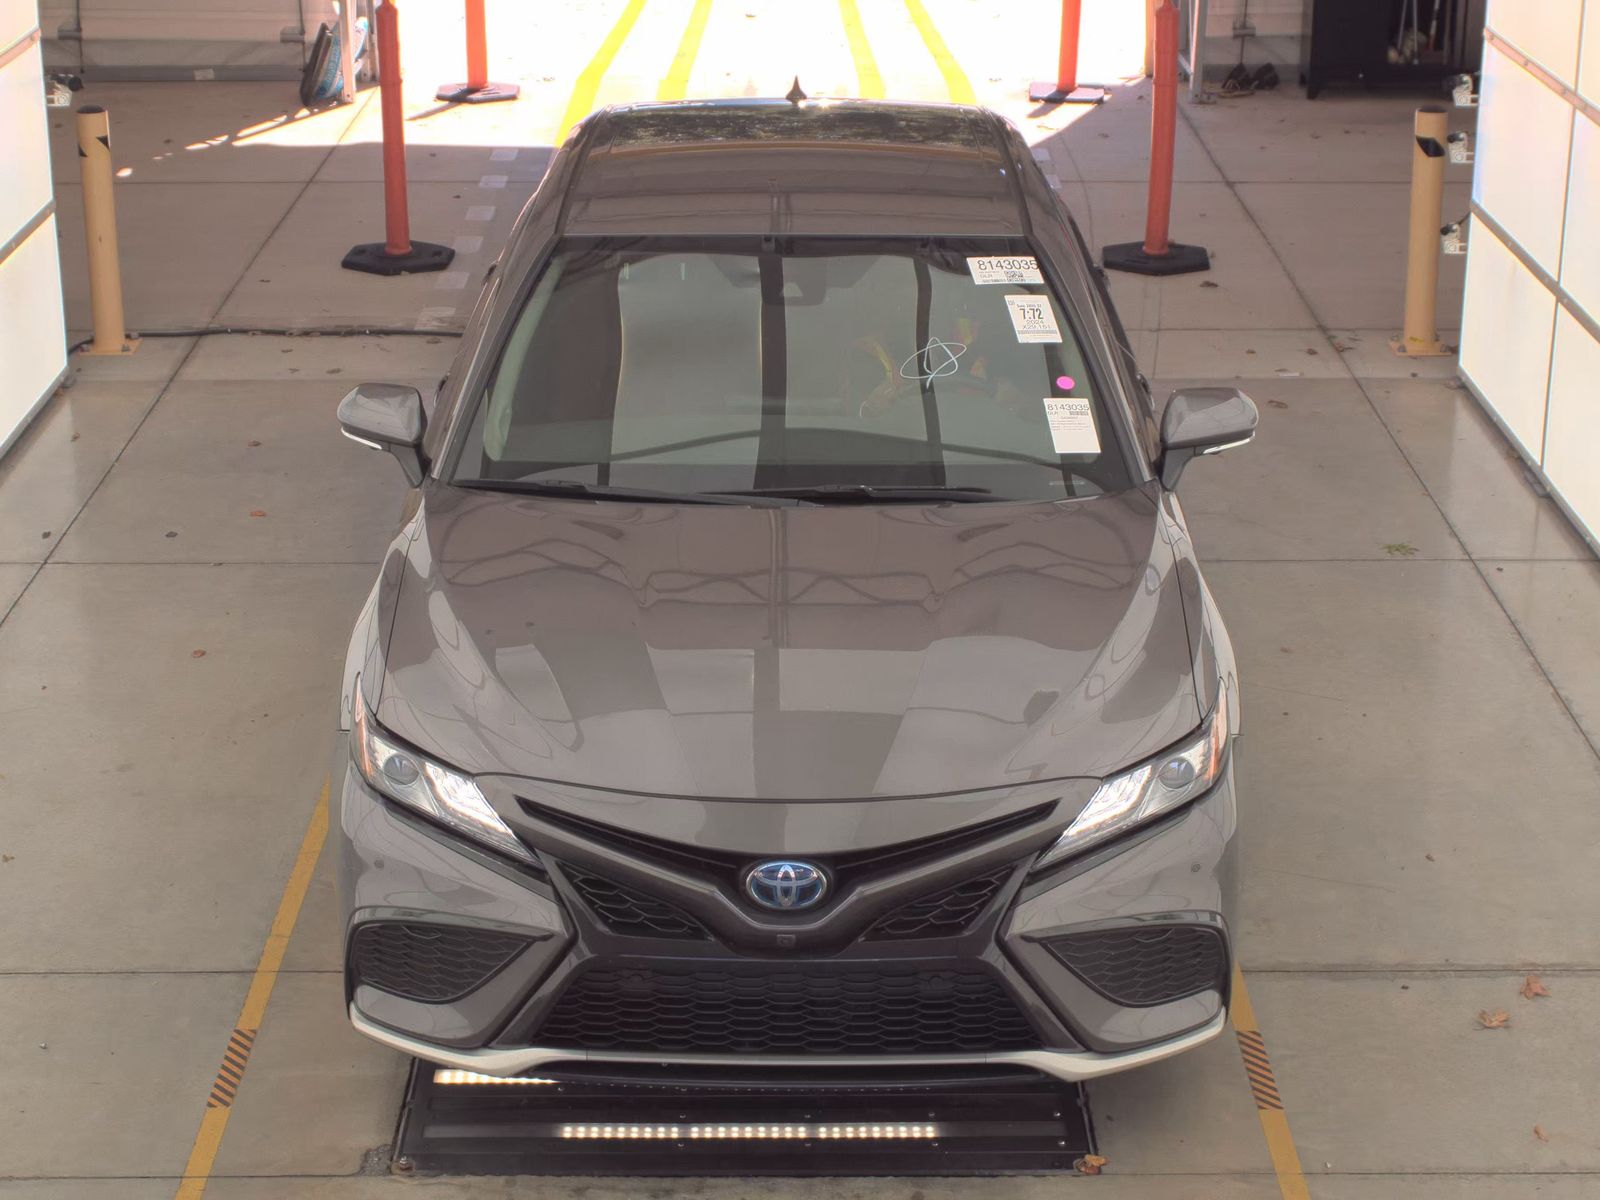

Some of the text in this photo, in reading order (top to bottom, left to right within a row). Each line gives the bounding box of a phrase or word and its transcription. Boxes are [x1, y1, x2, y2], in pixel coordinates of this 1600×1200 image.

[977, 259, 1040, 271] 8143035
[1019, 307, 1044, 320] 7:72
[1047, 403, 1090, 411] 8143035
